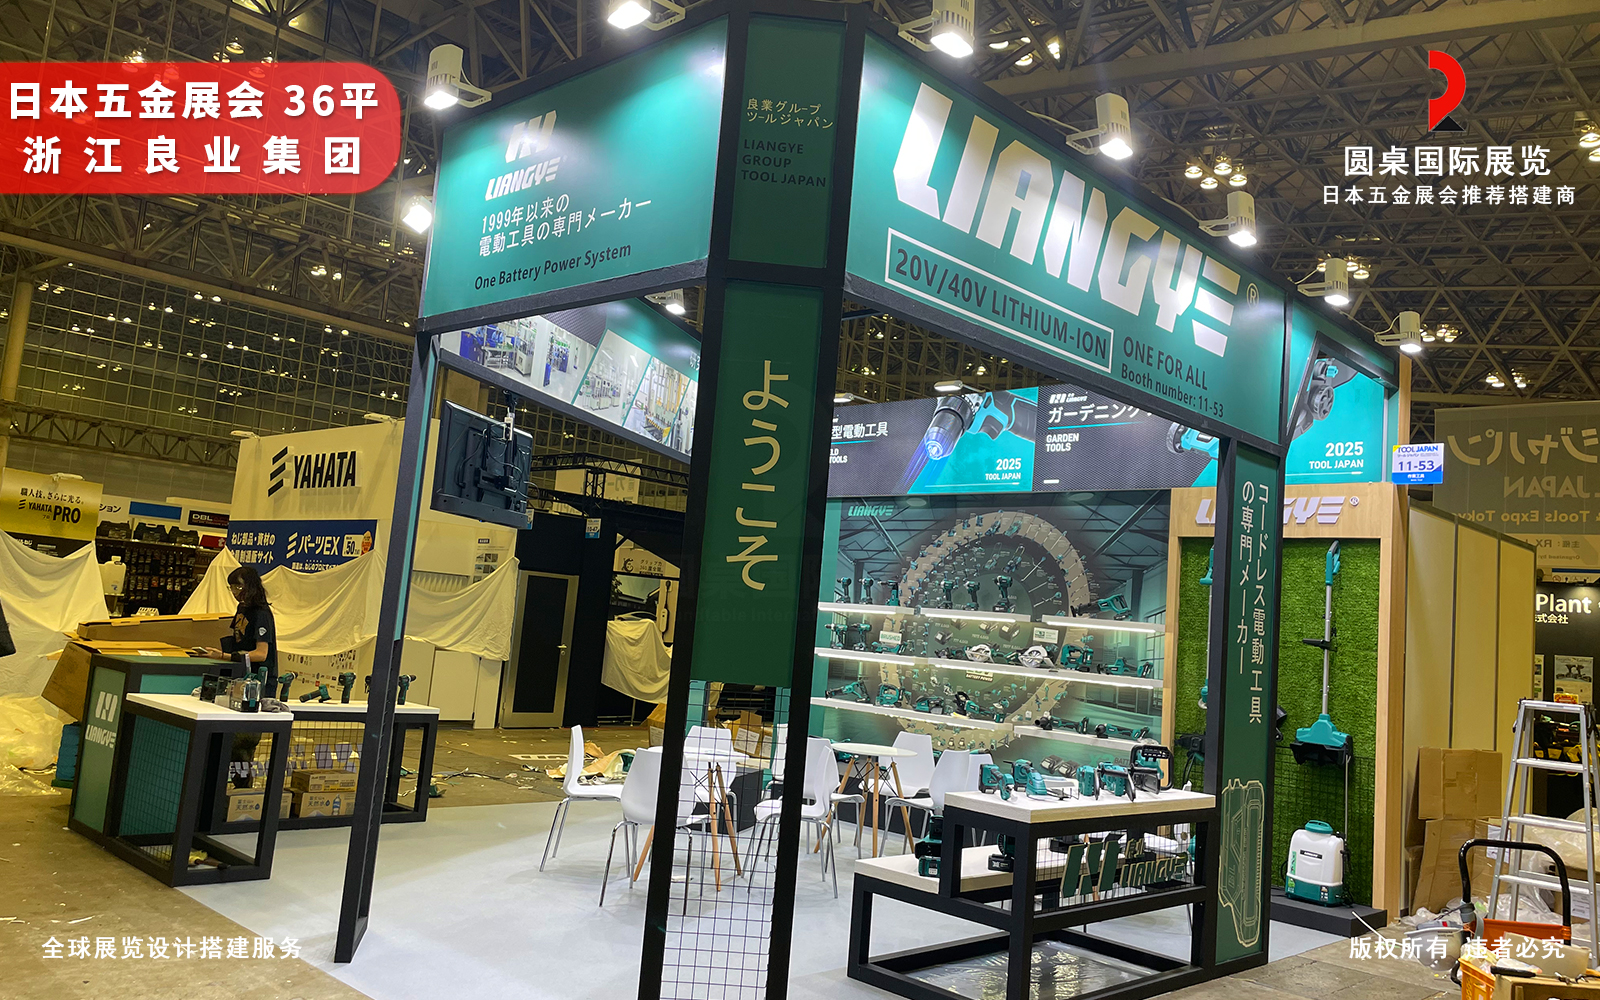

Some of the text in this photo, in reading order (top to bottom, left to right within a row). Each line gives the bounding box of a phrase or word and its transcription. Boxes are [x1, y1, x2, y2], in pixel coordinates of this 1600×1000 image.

[746, 98, 822, 116] 良業グループ
[746, 111, 834, 130] ツールジャパン
[743, 139, 804, 154] LIANGYE
[742, 155, 792, 169] GROUP
[484, 157, 561, 201] LIANGYE
[741, 169, 827, 188] TOOL JAPAN
[481, 193, 569, 234] 1999年以来の
[893, 82, 1241, 357] LIANGYE
[478, 198, 652, 257] 電動工具の専門メーカー
[474, 243, 632, 291] One Battery Power System
[895, 248, 1107, 361] 20V/40V LITHIUM-ION
[1123, 336, 1208, 391] ONE FOR ALL
[1121, 363, 1225, 418] Booth number: 11-53
[1046, 433, 1079, 443] GARDEN
[1046, 443, 1071, 452] TOOLS
[1325, 441, 1363, 457] 2025
[1416, 445, 1439, 453] JAPAN
[293, 450, 357, 490] YAHATA
[996, 458, 1021, 470] 2025
[1309, 458, 1364, 470] TOOL JAPAN
[1398, 460, 1435, 471] 11-53
[725, 360, 789, 591] ようこそ
[1001, 472, 1021, 480] JAPAN
[29, 501, 81, 524] YAHATA PRO
[848, 504, 894, 517] LIANGYE
[231, 532, 276, 546] ねじ部品・資材の
[298, 535, 340, 556] パーツEX
[1237, 481, 1255, 674] の専門メーカー
[1249, 483, 1269, 724] コードレス電動工具
[1535, 593, 1592, 614] Plant
[85, 724, 116, 749] LIANGYE
